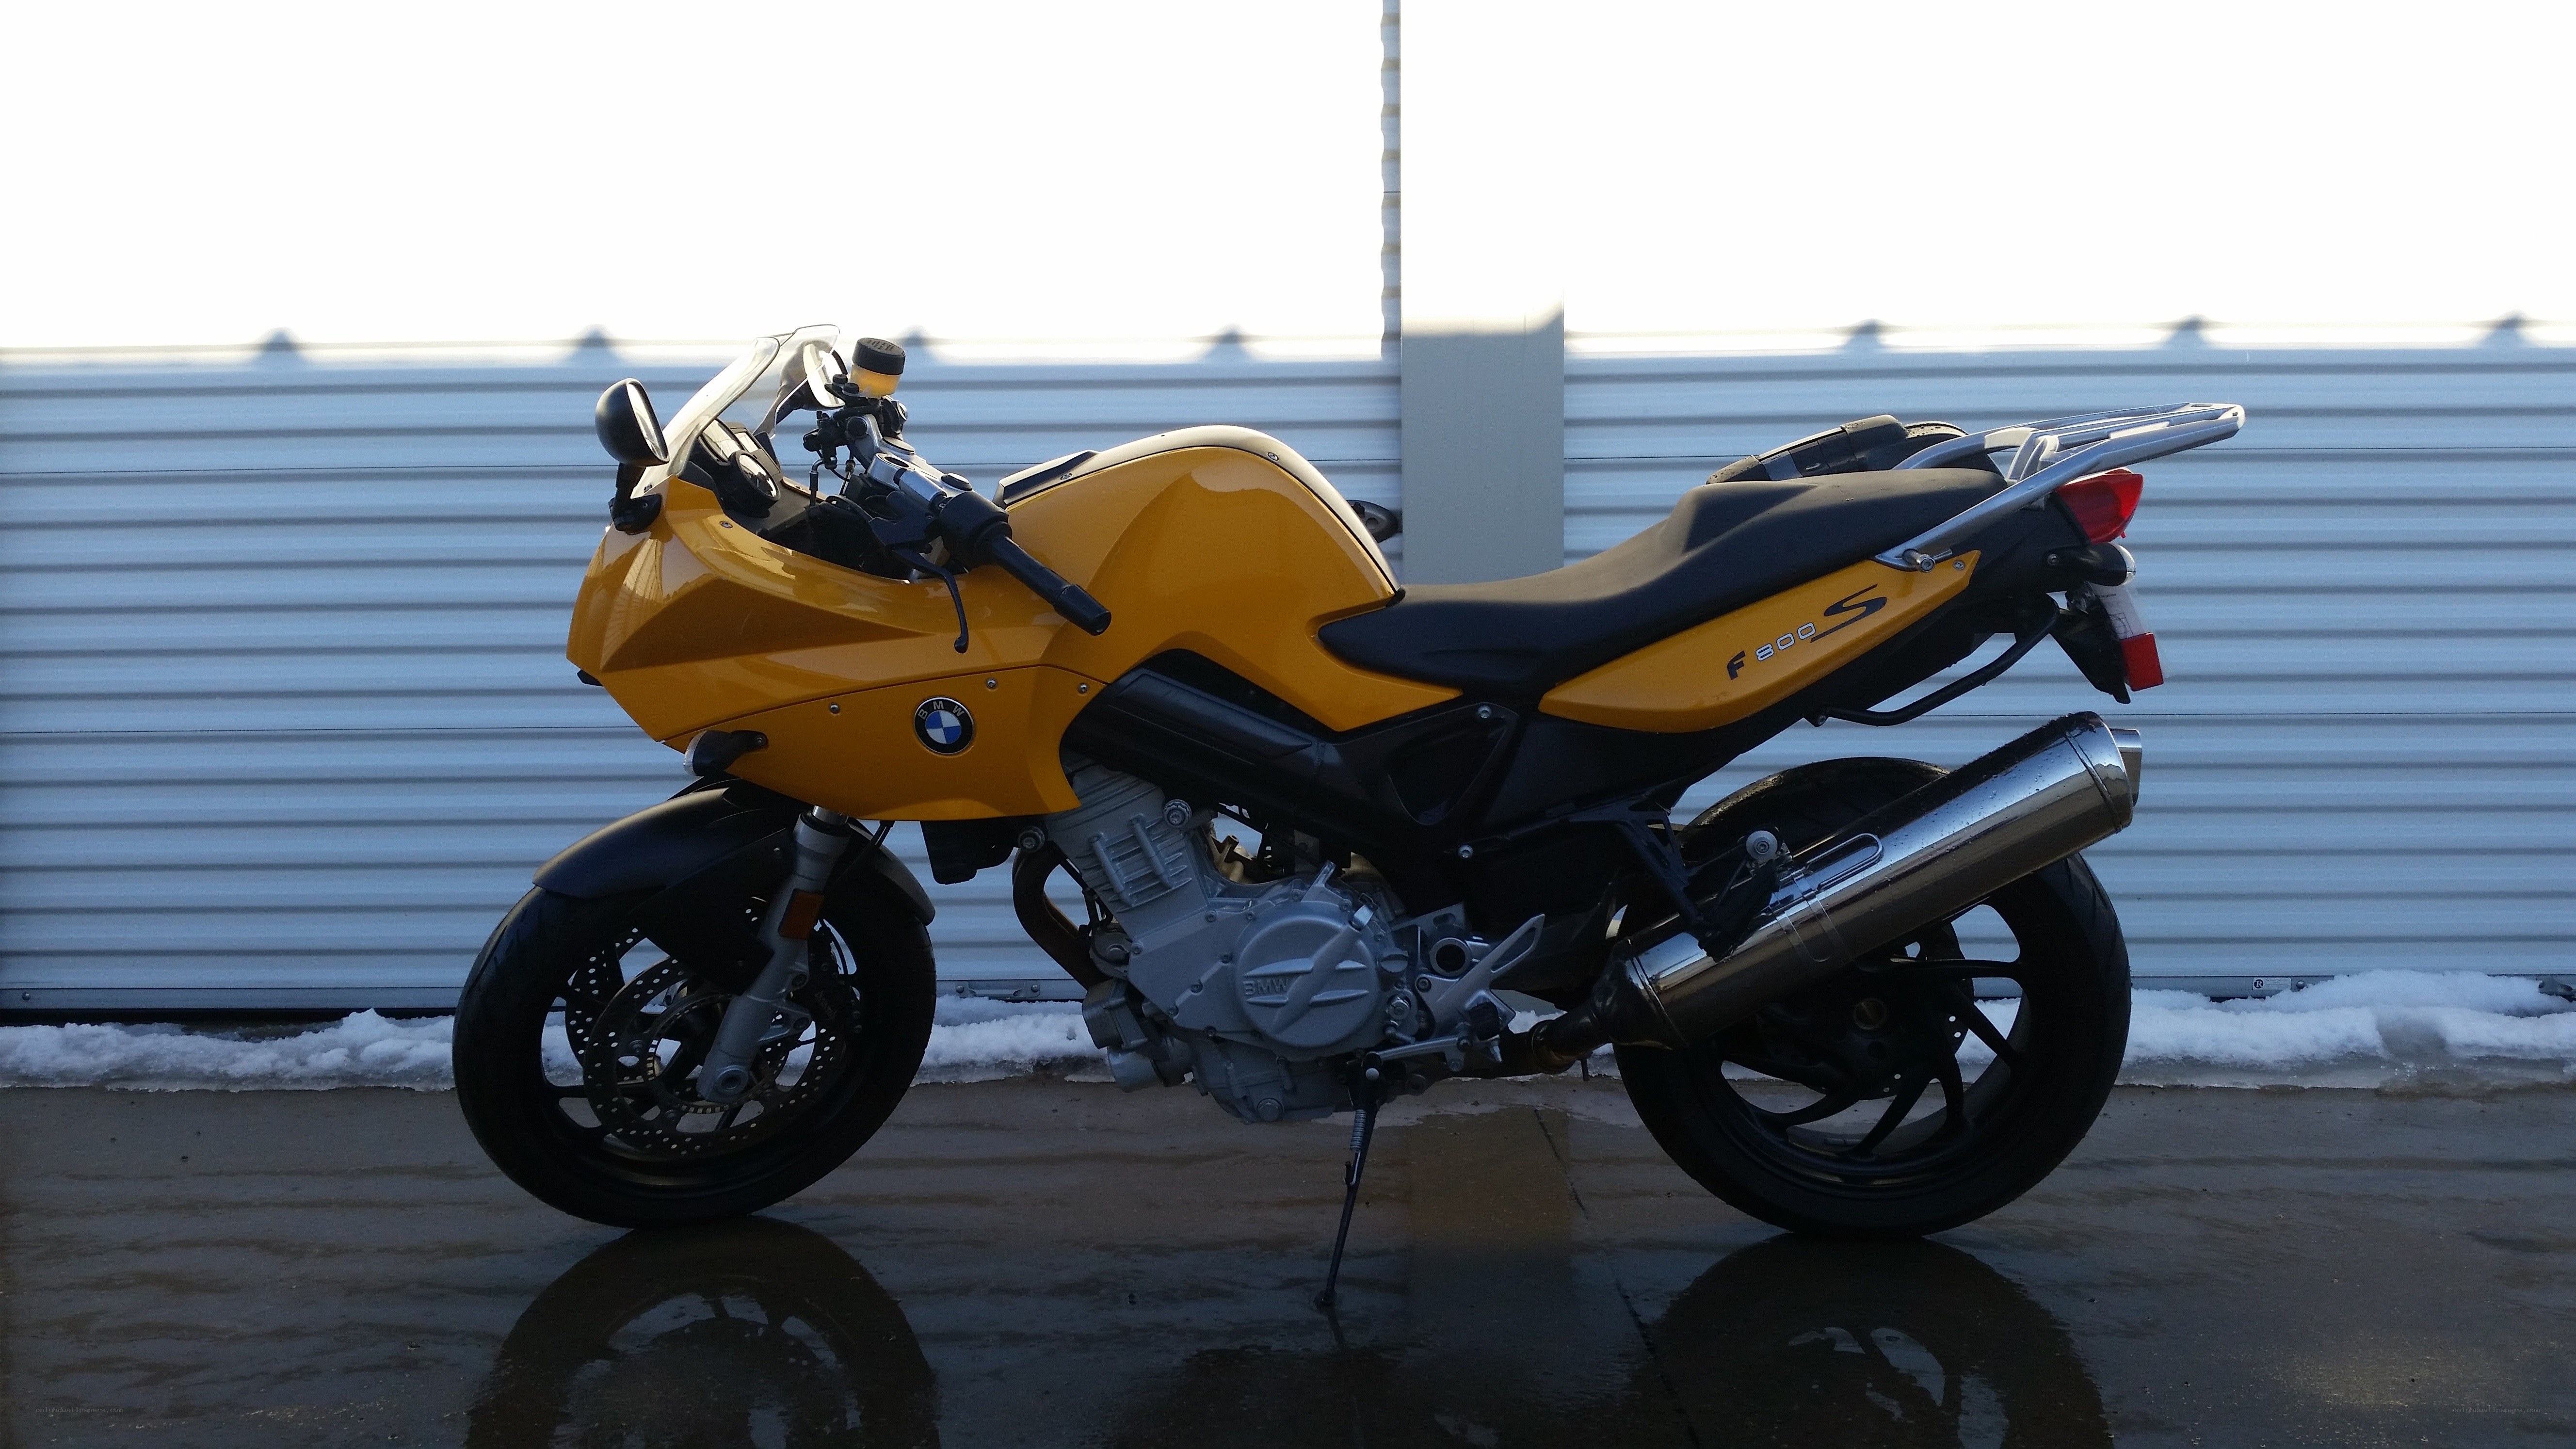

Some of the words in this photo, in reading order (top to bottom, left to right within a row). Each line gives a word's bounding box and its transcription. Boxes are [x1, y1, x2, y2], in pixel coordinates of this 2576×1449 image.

[1726, 650, 1746, 680] F
[1755, 622, 1816, 661] 800
[1810, 583, 1887, 643] S
[918, 701, 964, 720] BMW
[1242, 978, 1289, 995] BMW
